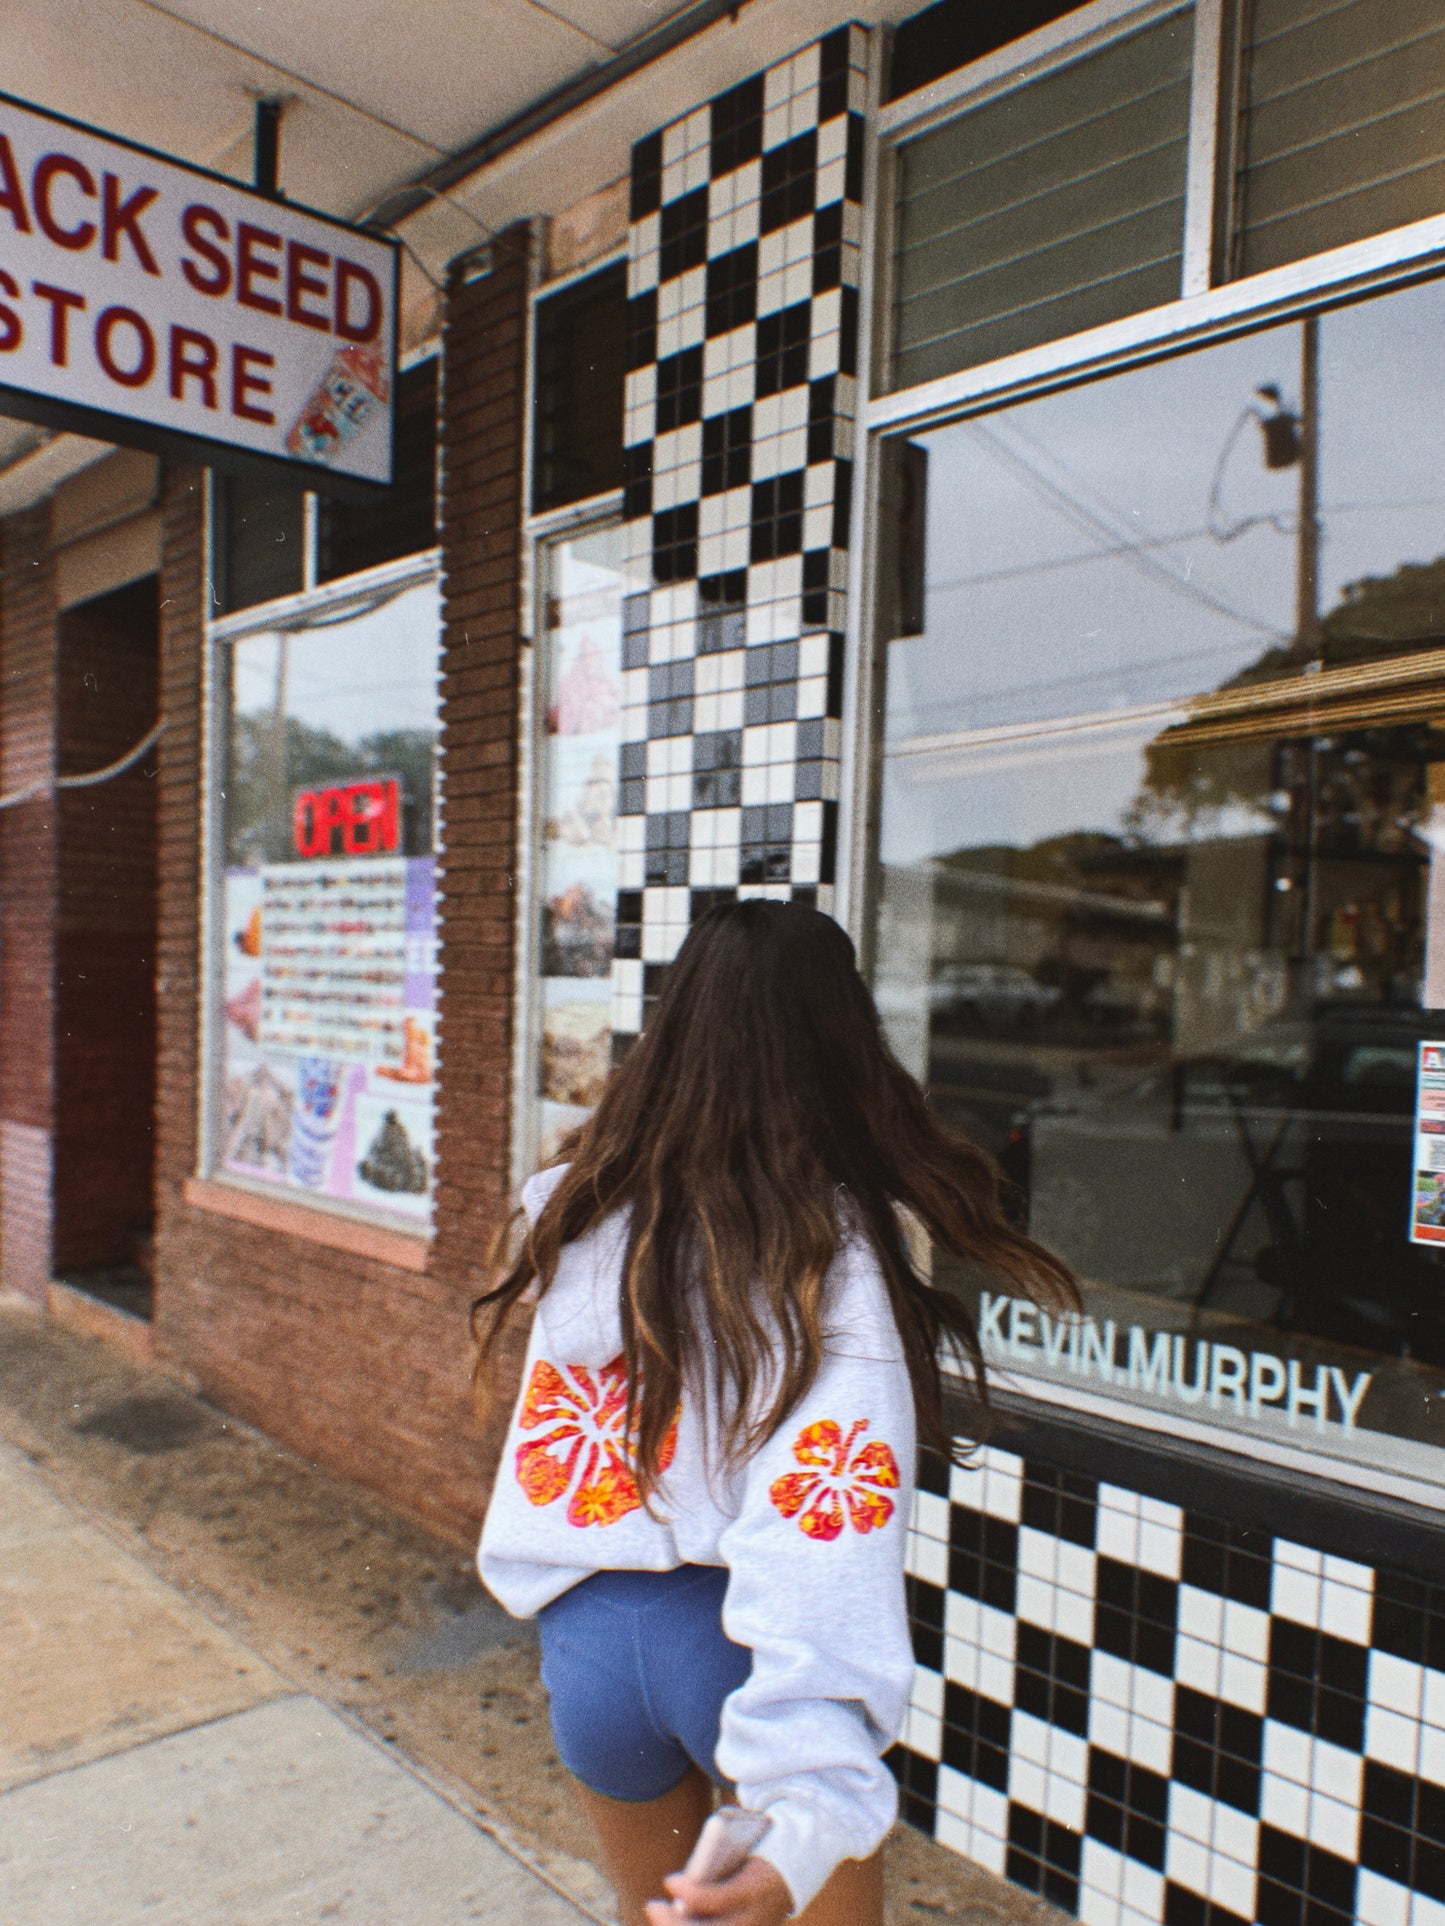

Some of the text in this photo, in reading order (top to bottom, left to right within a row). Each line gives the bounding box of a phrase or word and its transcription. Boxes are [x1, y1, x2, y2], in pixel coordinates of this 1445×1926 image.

[0, 133, 384, 344] ACK SEED
[295, 779, 398, 857] OPEN
